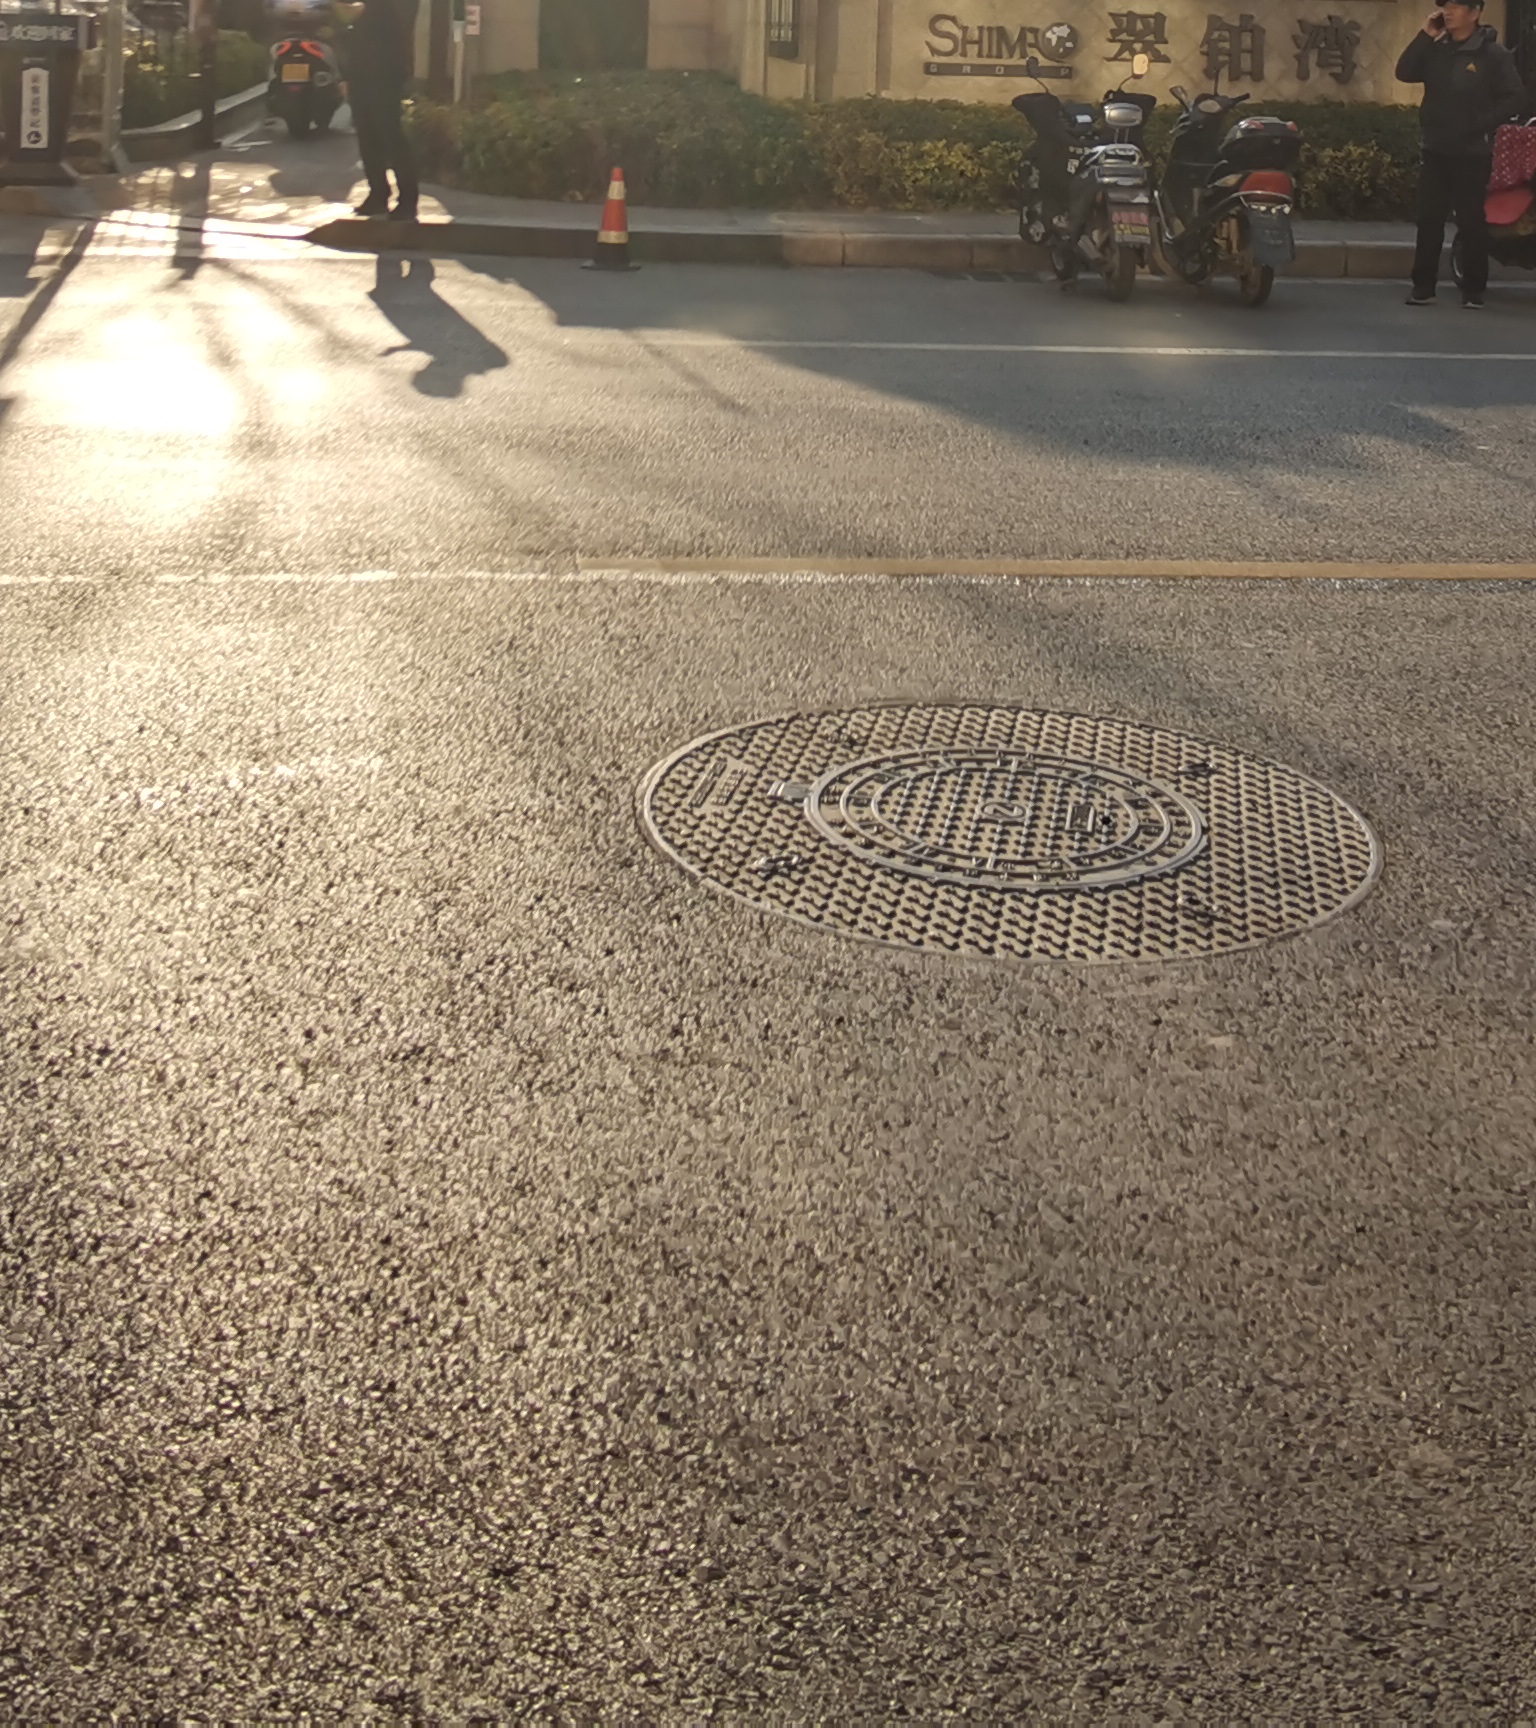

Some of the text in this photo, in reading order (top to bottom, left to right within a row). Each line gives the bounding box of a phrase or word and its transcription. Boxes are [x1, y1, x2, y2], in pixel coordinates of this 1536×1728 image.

[1104, 11, 1362, 84] 翠铂湾
[929, 64, 1070, 76] GROP
